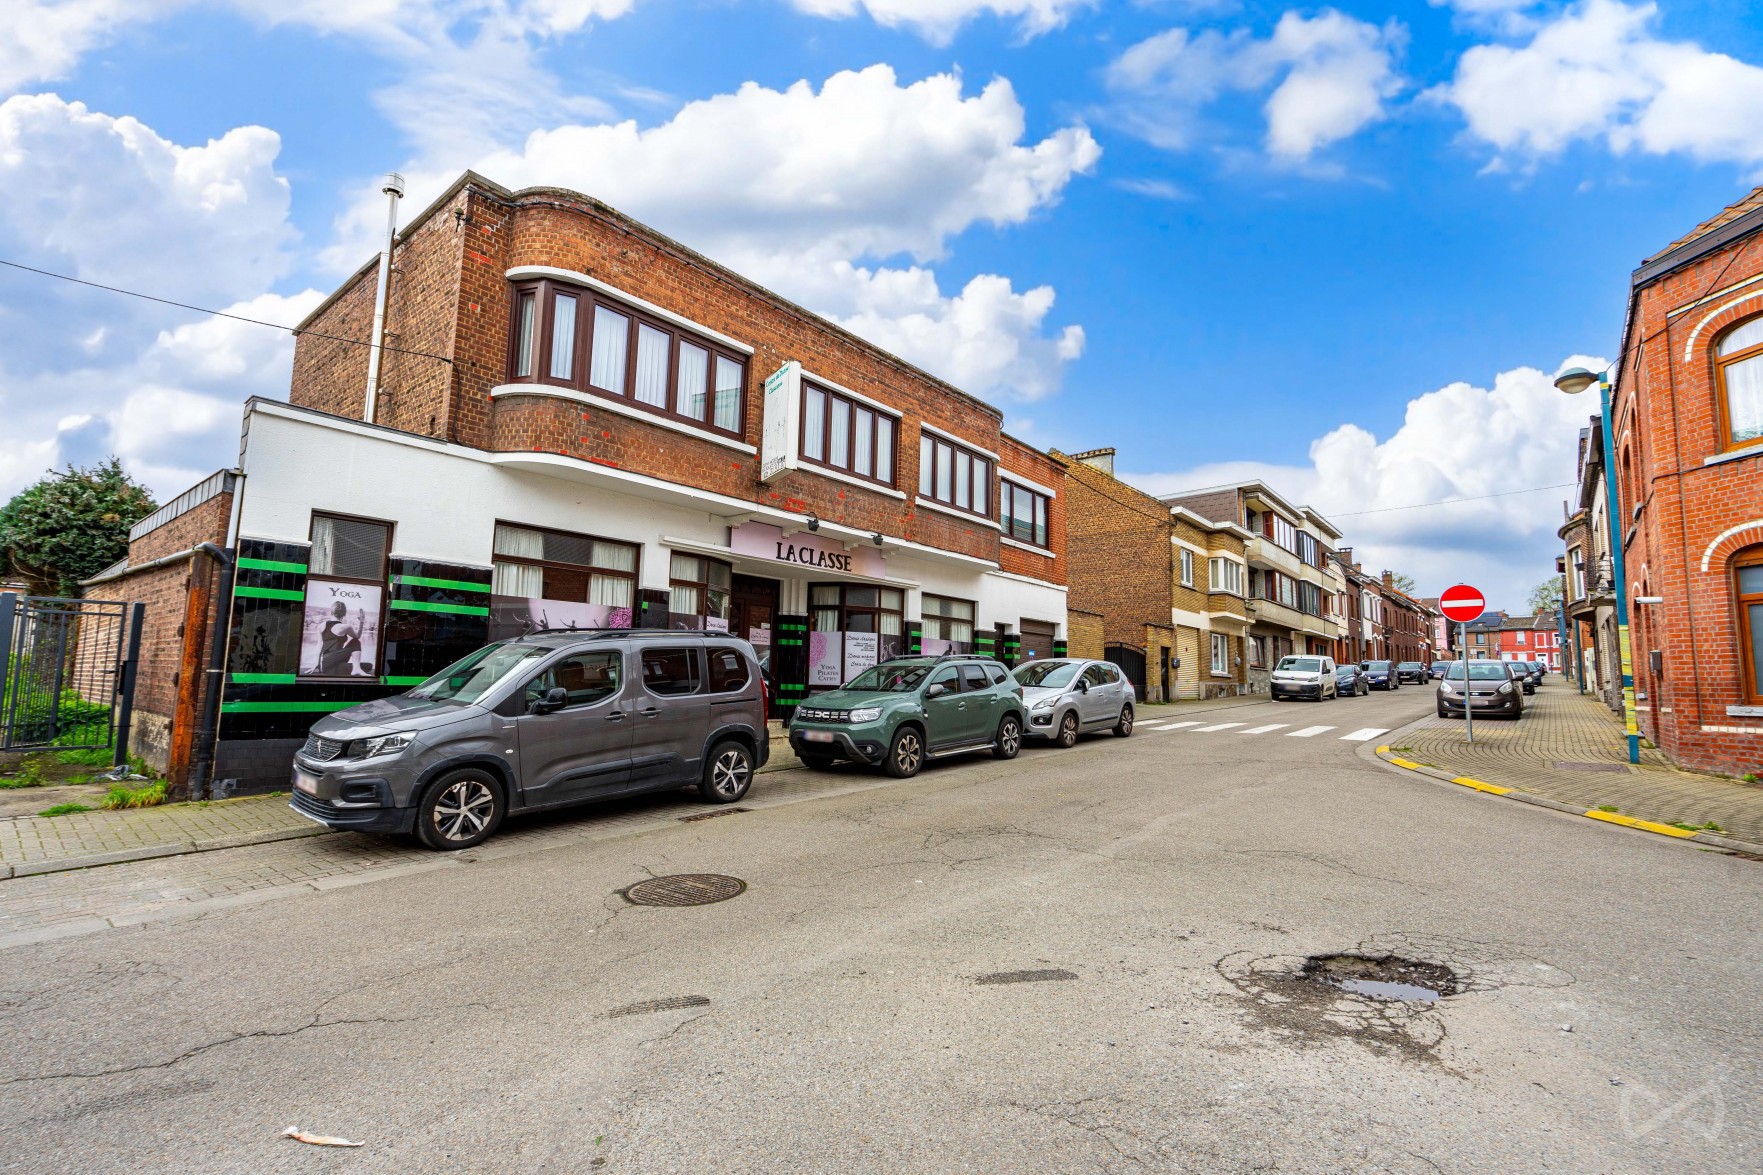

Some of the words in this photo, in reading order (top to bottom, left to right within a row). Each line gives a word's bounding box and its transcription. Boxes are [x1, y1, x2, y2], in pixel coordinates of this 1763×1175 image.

[776, 541, 797, 562] LA
[799, 547, 852, 572] CLASSE
[329, 587, 362, 599] YOGA
